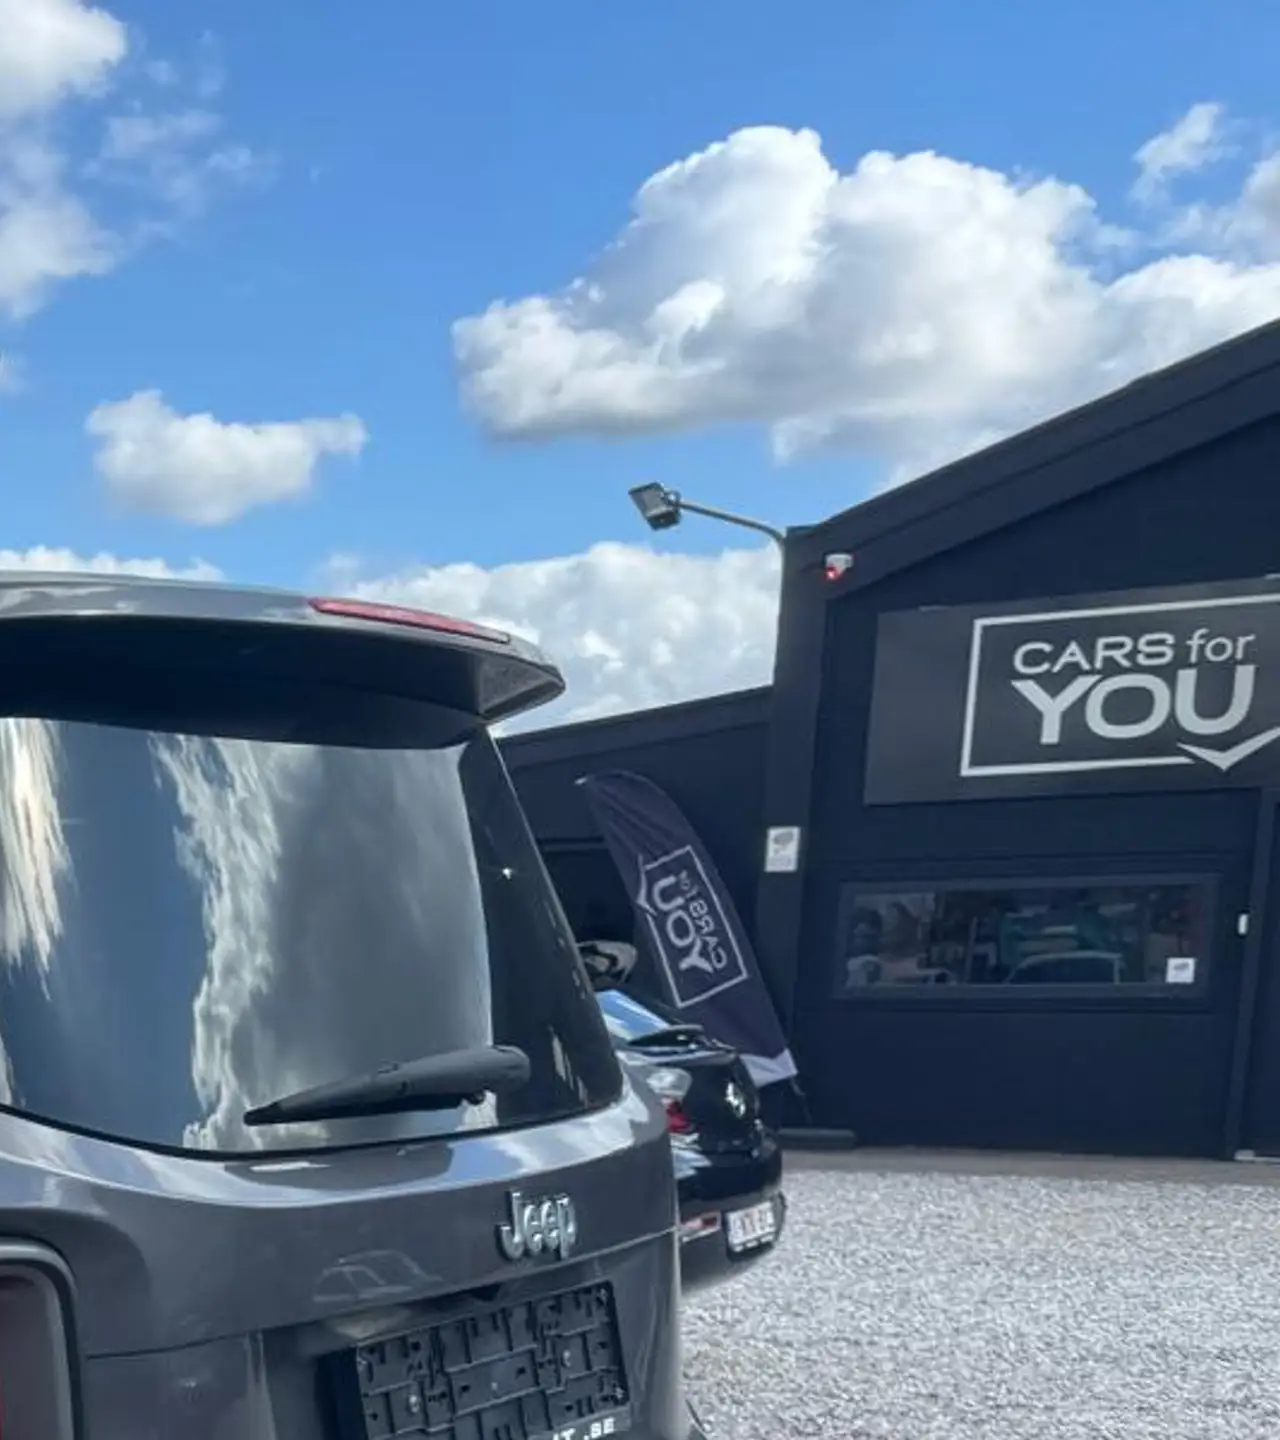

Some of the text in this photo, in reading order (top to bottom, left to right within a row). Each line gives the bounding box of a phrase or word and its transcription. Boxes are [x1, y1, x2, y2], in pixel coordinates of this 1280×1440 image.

[1013, 628, 1256, 674] CARS for
[1011, 665, 1256, 744] YOU
[499, 1192, 576, 1259] Jeep
